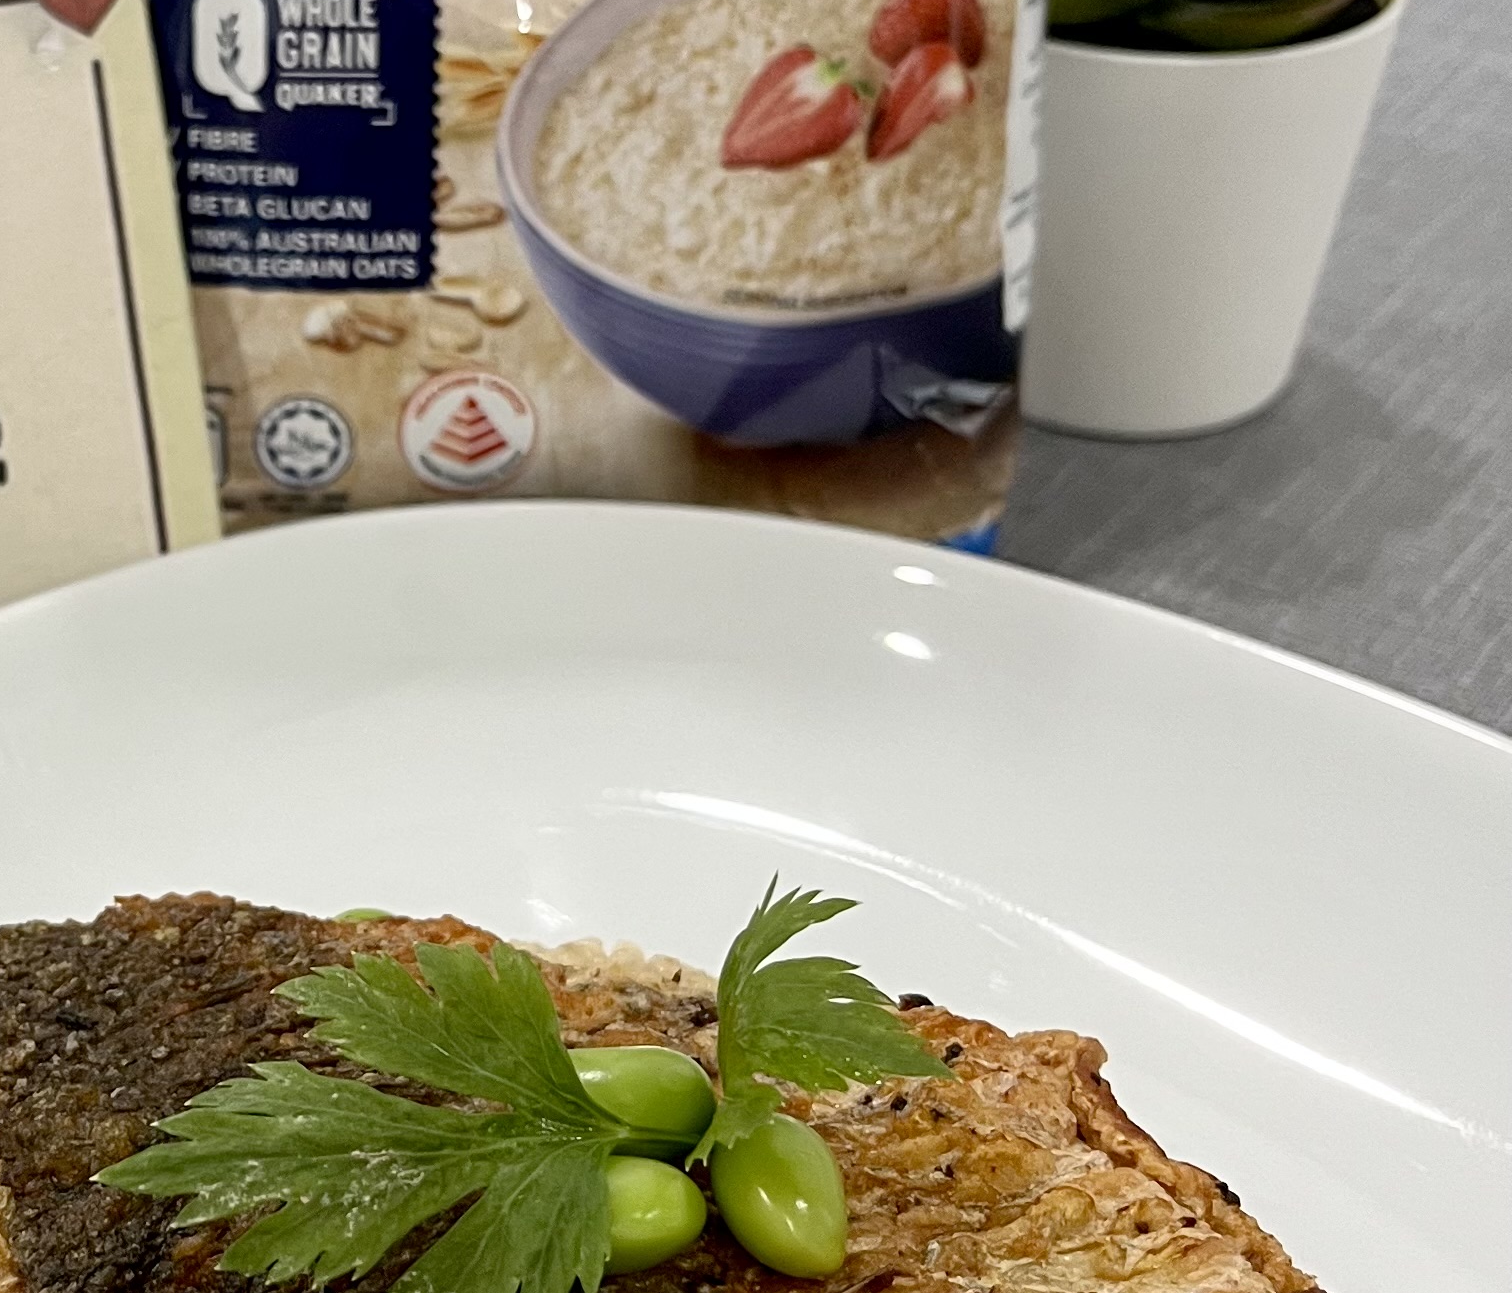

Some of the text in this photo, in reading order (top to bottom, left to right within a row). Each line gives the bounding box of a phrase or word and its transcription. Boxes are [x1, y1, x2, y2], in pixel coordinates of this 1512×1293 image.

[275, 29, 381, 70] GRAIN
[187, 127, 258, 153] FIBRE
[187, 161, 299, 188] PROTEIN
[188, 191, 371, 221] BETA GLUCAN
[254, 229, 421, 254] AUSTRALIAN
[352, 256, 420, 280] OATS
